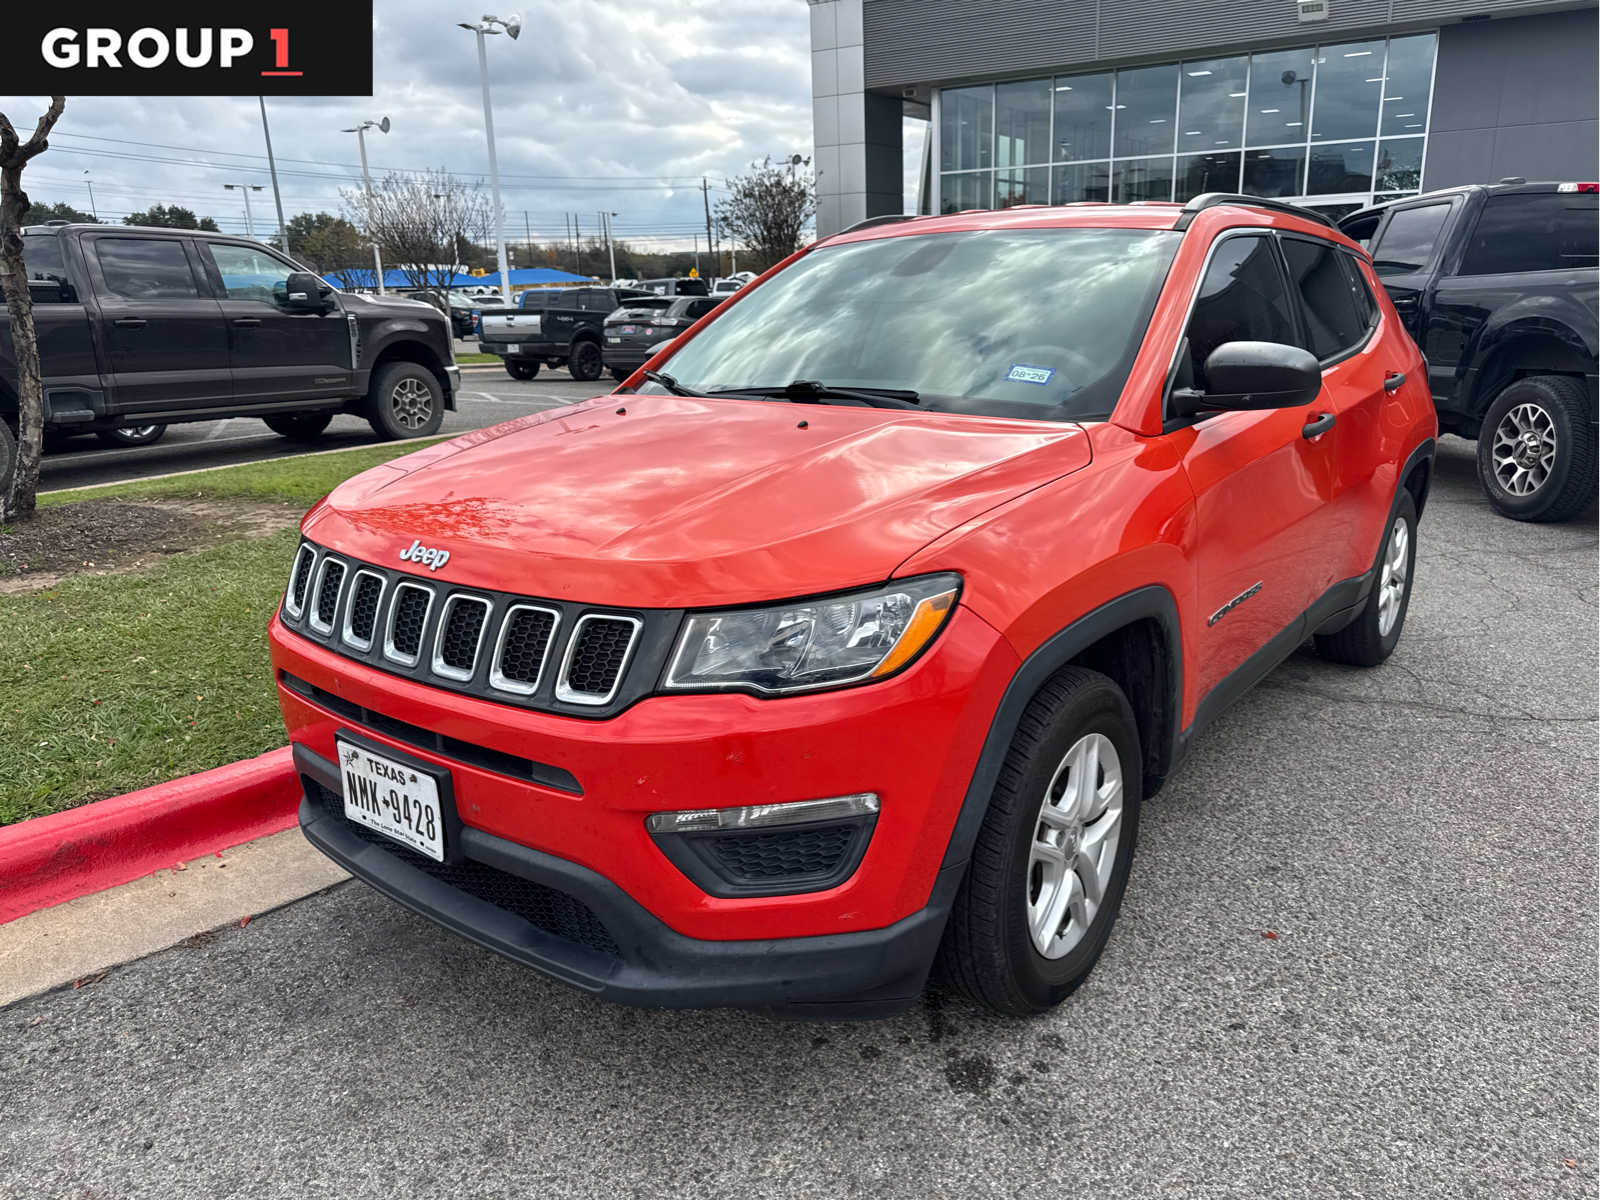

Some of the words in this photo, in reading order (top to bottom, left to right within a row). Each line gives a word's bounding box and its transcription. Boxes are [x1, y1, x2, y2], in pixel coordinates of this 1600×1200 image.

[399, 540, 450, 571] Jeep
[367, 758, 406, 785] TEXAS
[347, 771, 382, 817] NMK
[389, 789, 436, 841] 9428
